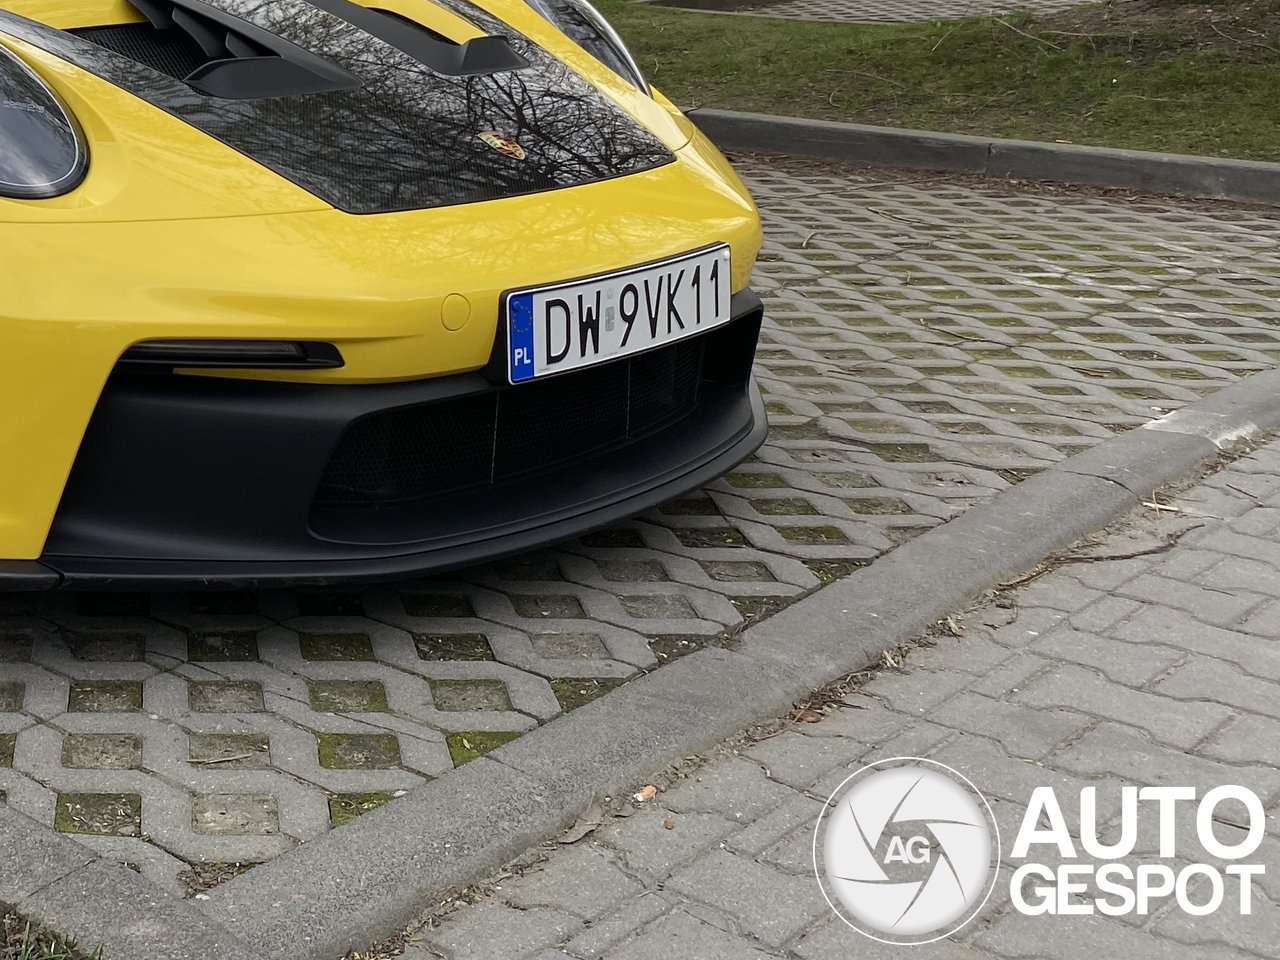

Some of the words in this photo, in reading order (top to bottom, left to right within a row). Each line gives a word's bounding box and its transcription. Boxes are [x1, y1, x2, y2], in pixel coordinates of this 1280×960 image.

[545, 290, 601, 365] DW
[619, 258, 719, 348] 9VK11
[514, 347, 531, 366] PL
